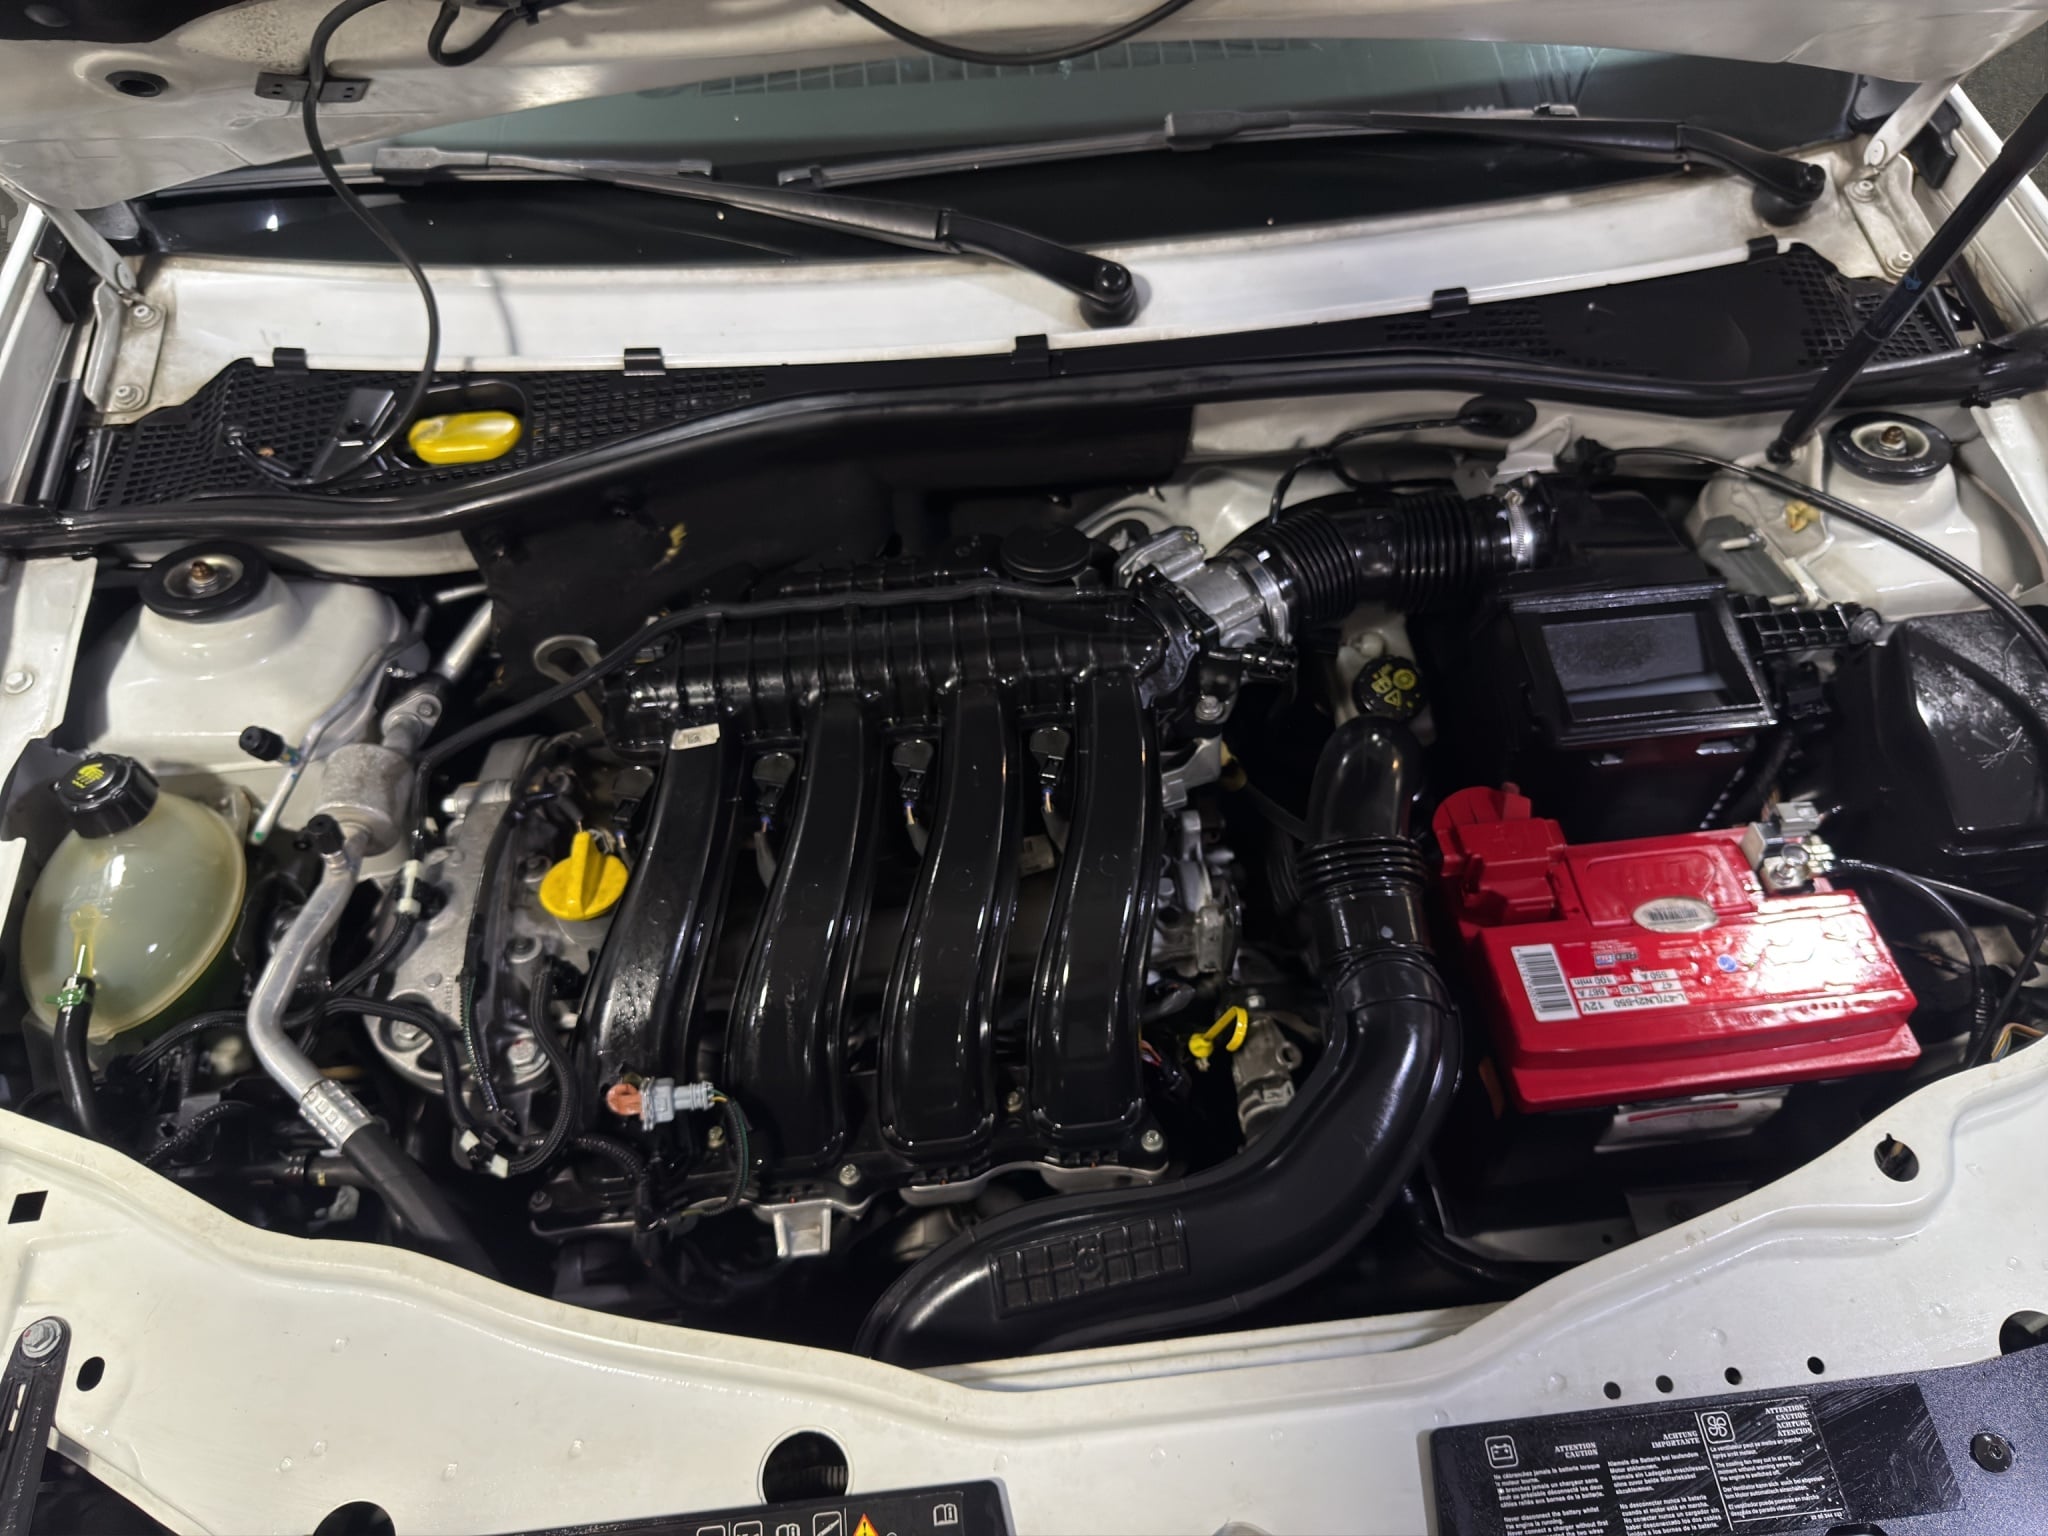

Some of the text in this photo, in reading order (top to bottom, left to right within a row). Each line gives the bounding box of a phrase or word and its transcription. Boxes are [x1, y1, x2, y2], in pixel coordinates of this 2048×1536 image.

[1574, 978, 1592, 986] min
[1595, 976, 1612, 984] 100
[1621, 985, 1640, 994] LN2
[1583, 1001, 1605, 1011] 12V
[1765, 1405, 1804, 1414] ATTENTION
[1776, 1412, 1807, 1421] CAUTION
[1776, 1419, 1810, 1429] ACHTUNG
[1663, 1431, 1698, 1440] ACHTUNG
[1652, 1437, 1700, 1448] IMPORTANTE
[1555, 1442, 1596, 1453] ATTENTION
[1565, 1449, 1598, 1458] CAUTION
